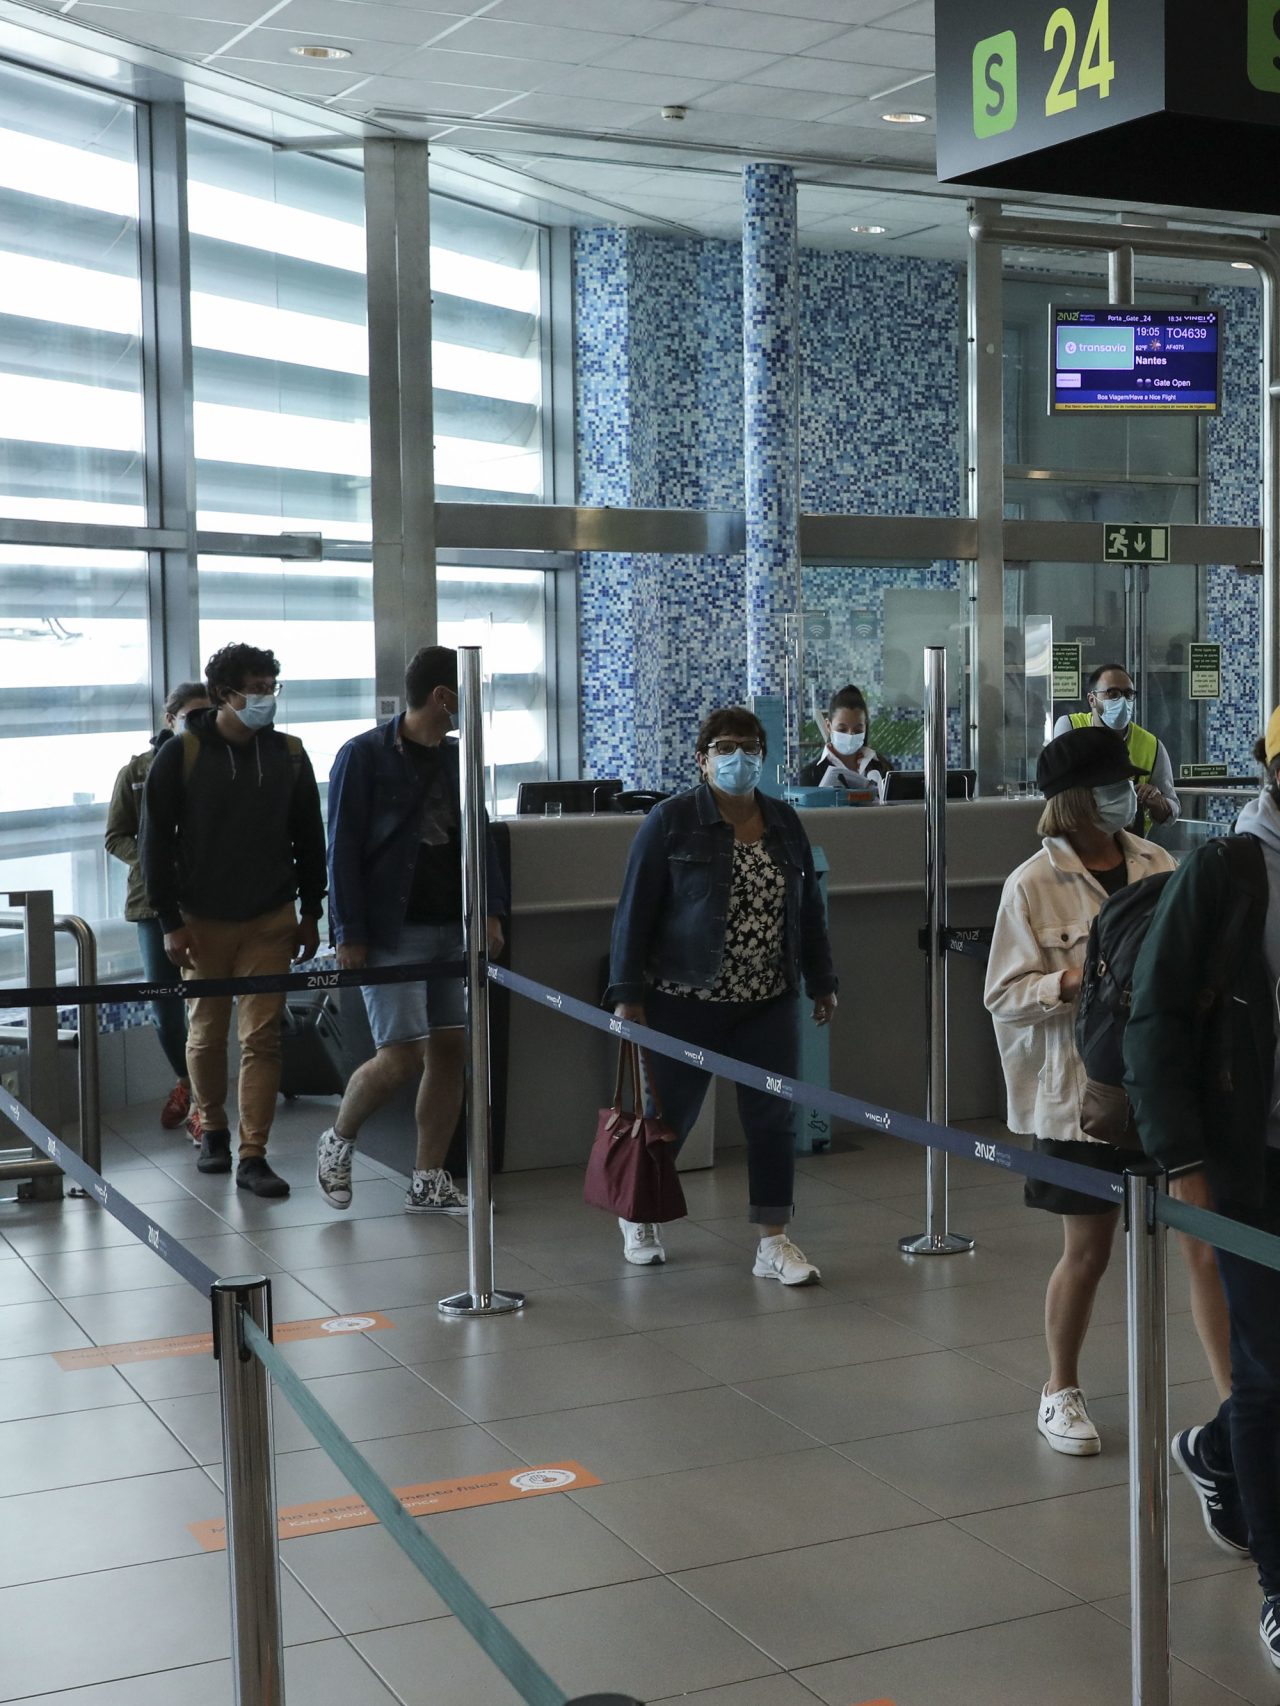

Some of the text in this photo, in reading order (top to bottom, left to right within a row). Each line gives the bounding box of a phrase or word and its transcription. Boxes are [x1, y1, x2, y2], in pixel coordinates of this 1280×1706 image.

[984, 0, 1115, 117] S 24
[1107, 314, 1122, 322] Porta
[1136, 327, 1207, 339] 19:05 TO4639
[1079, 343, 1127, 353] transavia
[1135, 356, 1167, 365] Nantes
[1154, 378, 1191, 388] Gate Open
[1163, 394, 1177, 402] Flight
[139, 988, 171, 996] VINCI
[684, 1050, 698, 1061] VINCI
[865, 1112, 883, 1123] VINCI
[1111, 1183, 1124, 1195] VIN
[289, 1516, 331, 1528] Keep
[334, 1510, 368, 1521] your
